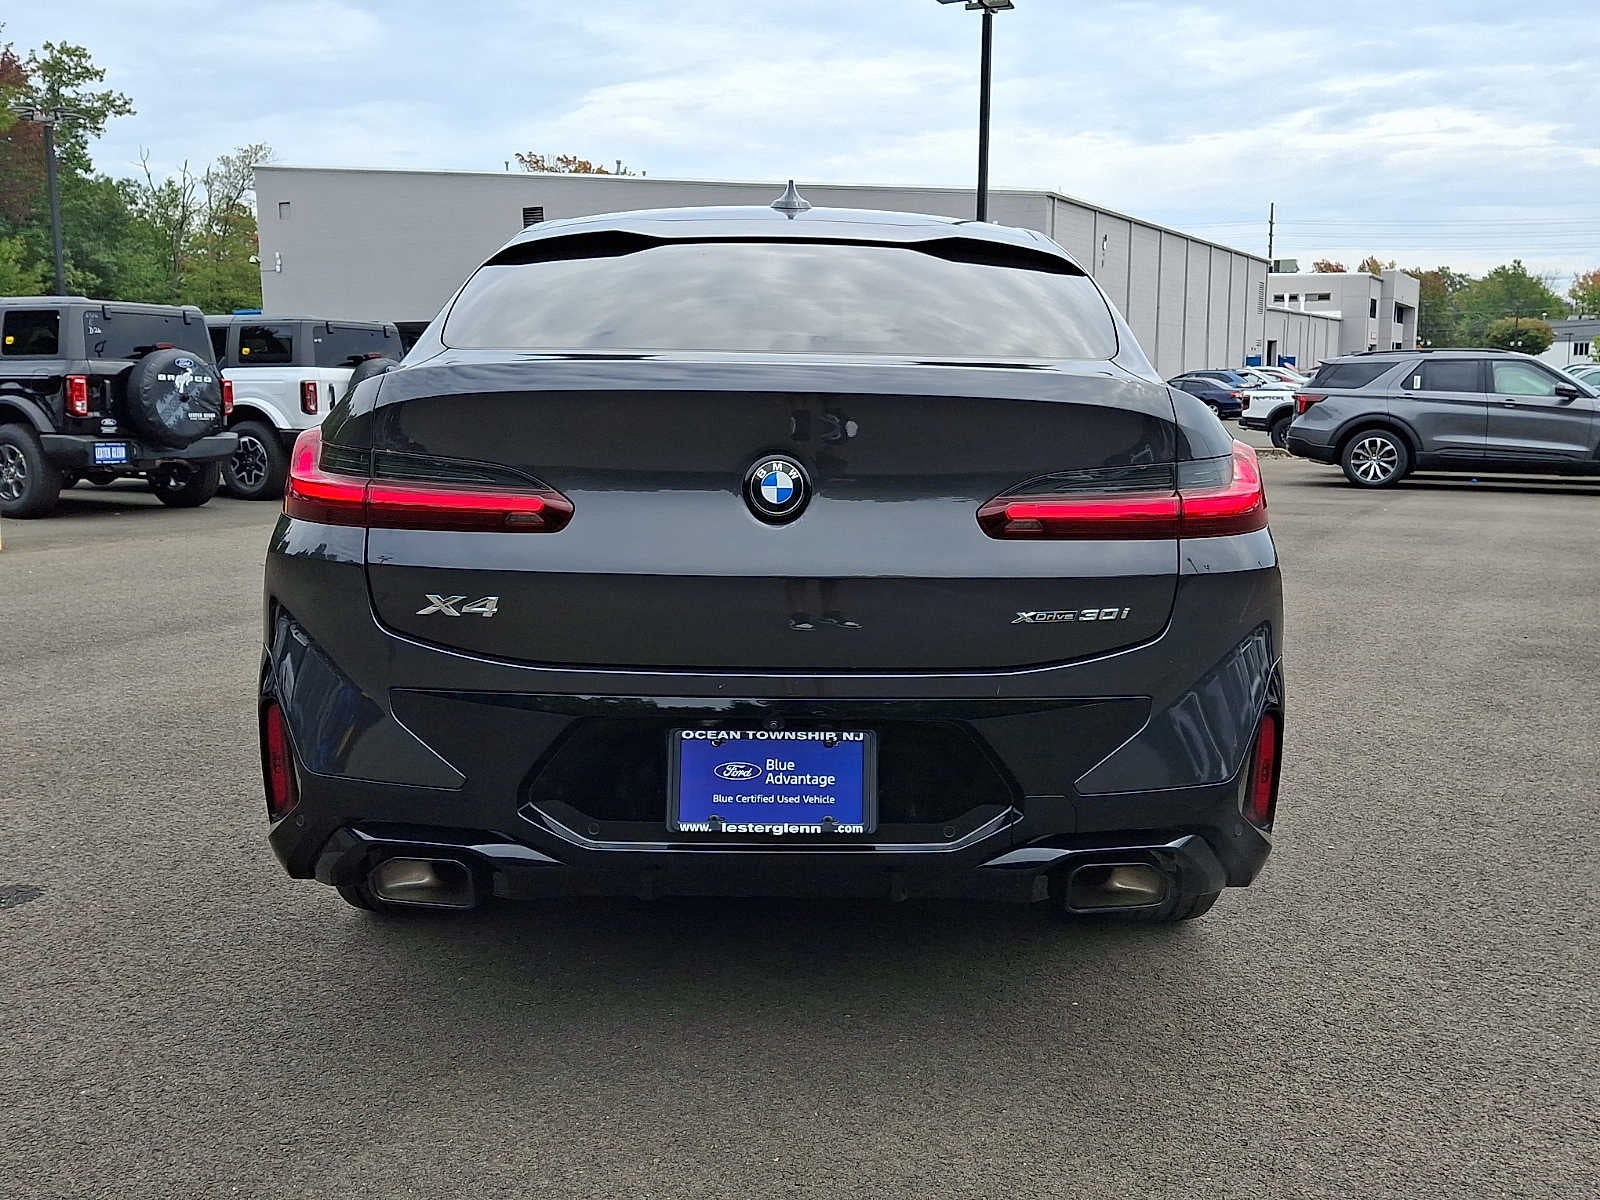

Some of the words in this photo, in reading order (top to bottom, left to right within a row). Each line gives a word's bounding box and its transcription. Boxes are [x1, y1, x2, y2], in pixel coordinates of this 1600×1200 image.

[756, 462, 799, 480] BMW
[415, 594, 499, 617] X4
[681, 730, 741, 740] OCEAN
[843, 732, 864, 741] NJ
[722, 764, 753, 778] Ford
[765, 758, 796, 771] Blue
[765, 773, 836, 788] Advantage
[712, 794, 733, 803] Blue
[735, 794, 775, 804] Certified
[777, 795, 800, 804] Used
[803, 795, 836, 805] Vehicle
[679, 824, 712, 833] www.
[721, 823, 822, 835] lesterglenn
[834, 824, 864, 834] .com
